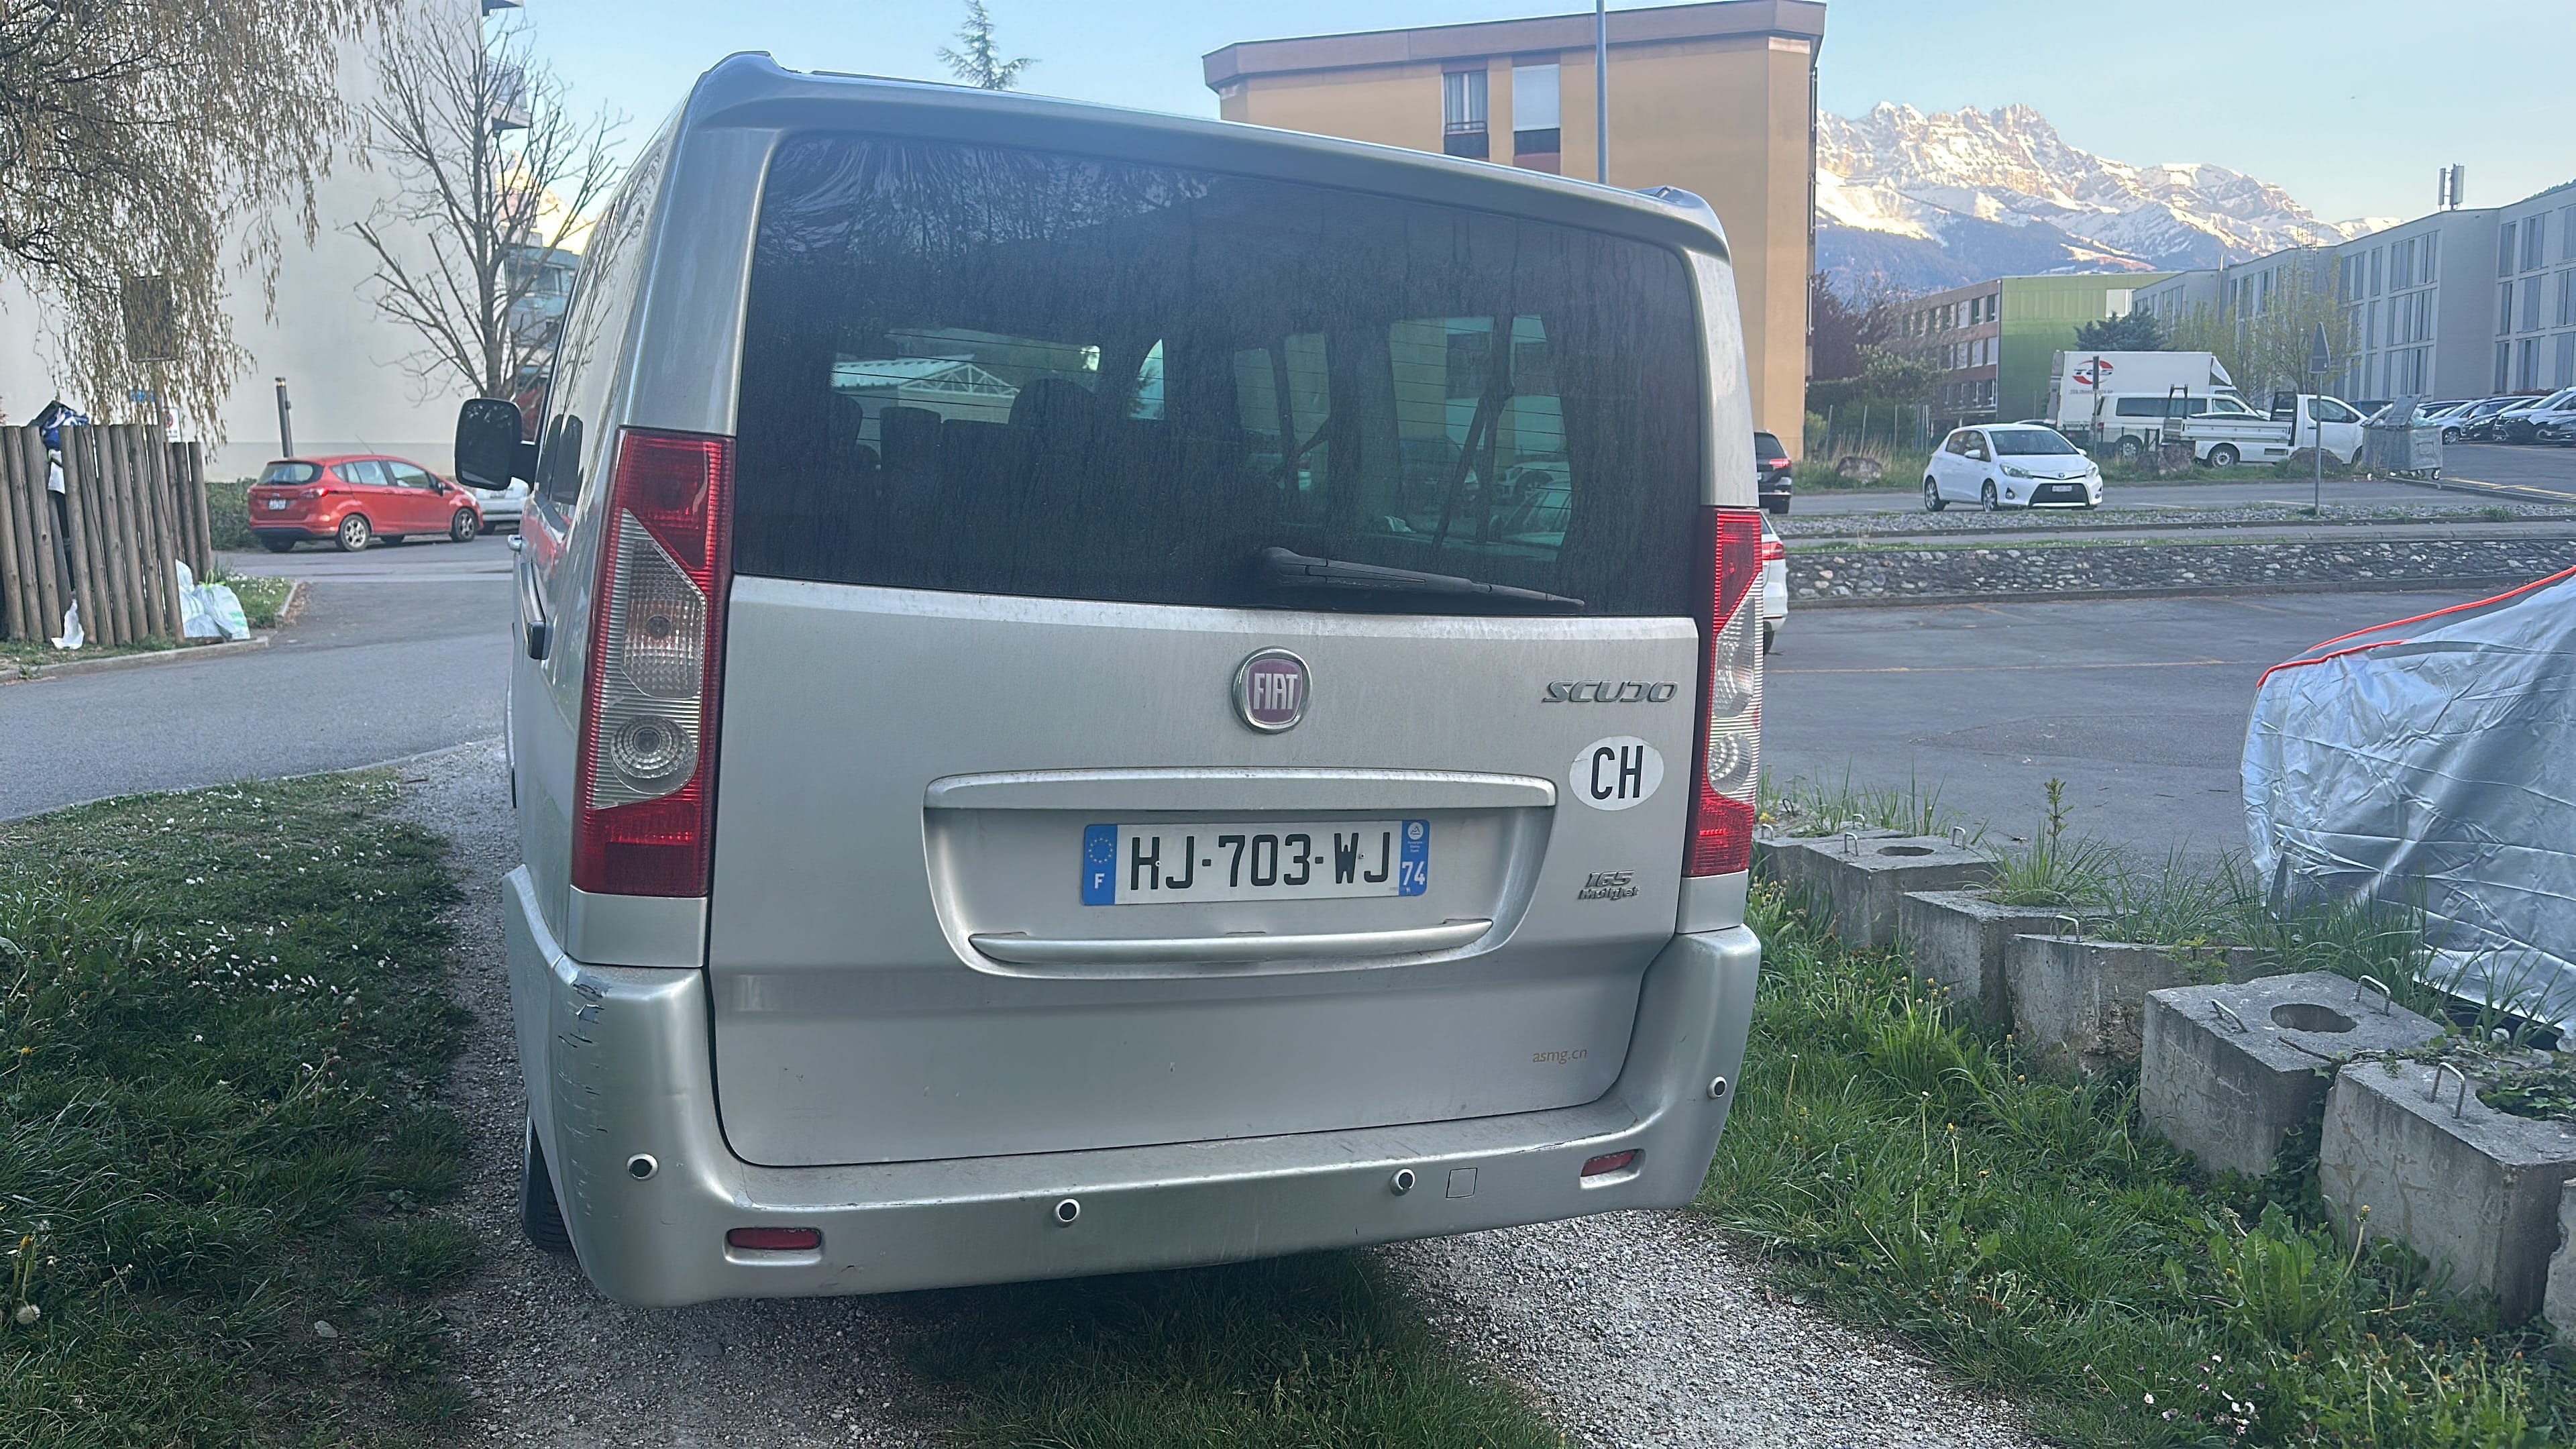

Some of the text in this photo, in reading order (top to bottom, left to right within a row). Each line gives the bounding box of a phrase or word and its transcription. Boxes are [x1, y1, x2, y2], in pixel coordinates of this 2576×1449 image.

[1253, 673, 1298, 710] FIAT
[1542, 680, 1678, 703] SCUDO
[1591, 745, 1644, 800] CH
[1130, 832, 1391, 890] HJ-703-WJ
[1094, 873, 1105, 889] F
[1401, 861, 1426, 886] 74
[1585, 870, 1635, 888] 165
[1532, 1049, 1588, 1065] asmg.cn
